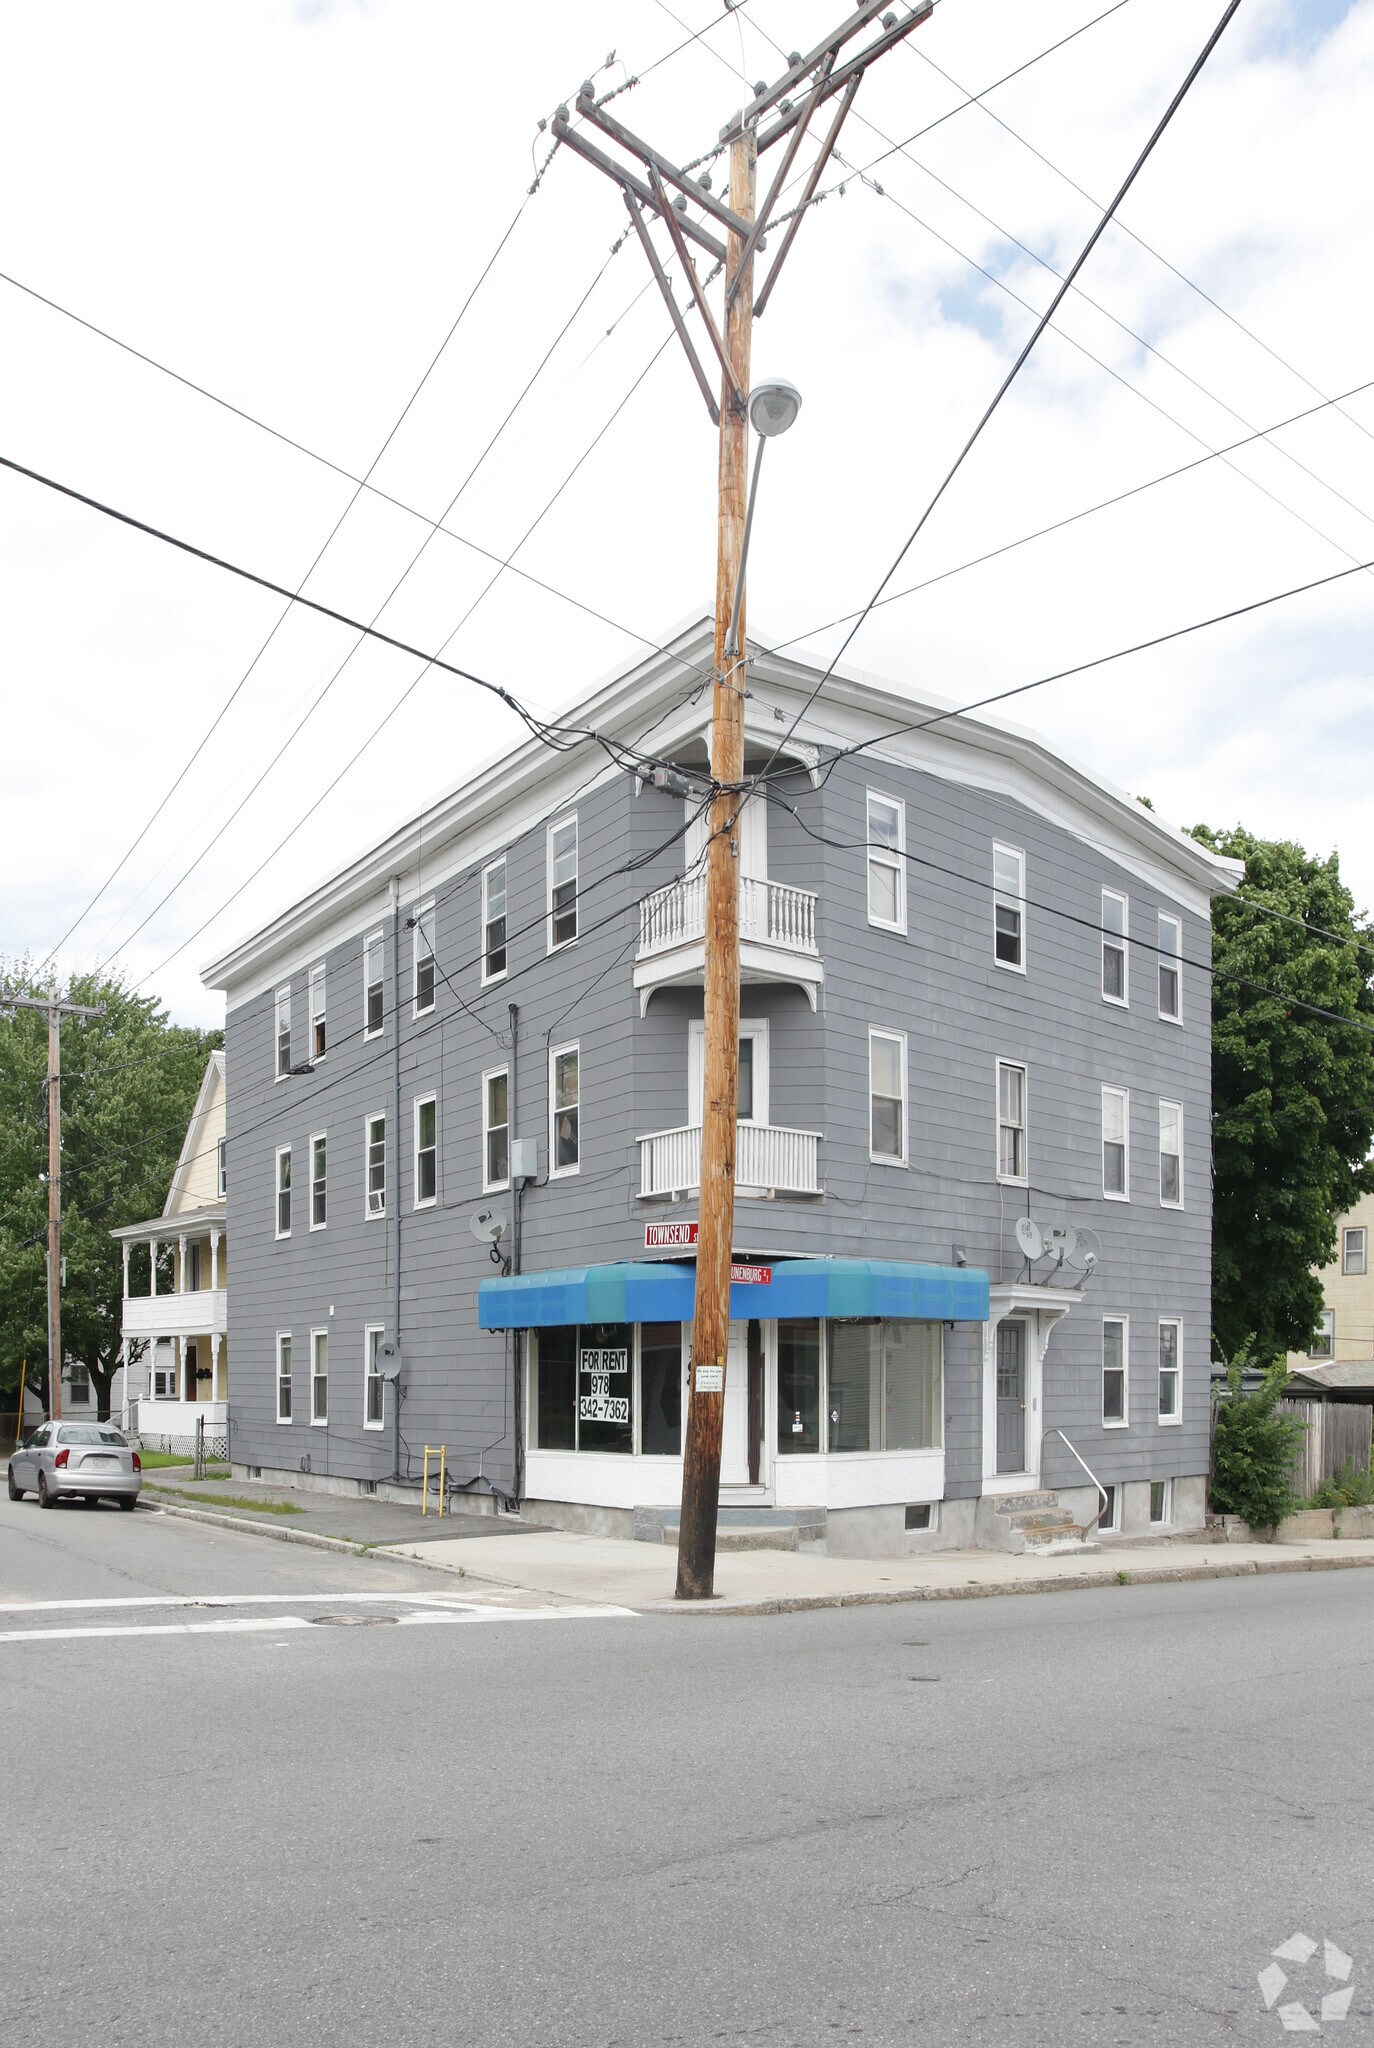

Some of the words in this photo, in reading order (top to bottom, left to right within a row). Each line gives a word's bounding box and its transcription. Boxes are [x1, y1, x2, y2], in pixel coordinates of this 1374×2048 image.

[648, 1225, 690, 1244] TOWNSEND
[730, 1266, 762, 1282] UNENBURG
[582, 1350, 599, 1370] FOR
[602, 1350, 626, 1370] RENT
[592, 1375, 609, 1395] 978
[580, 1398, 627, 1420] 342-7362
